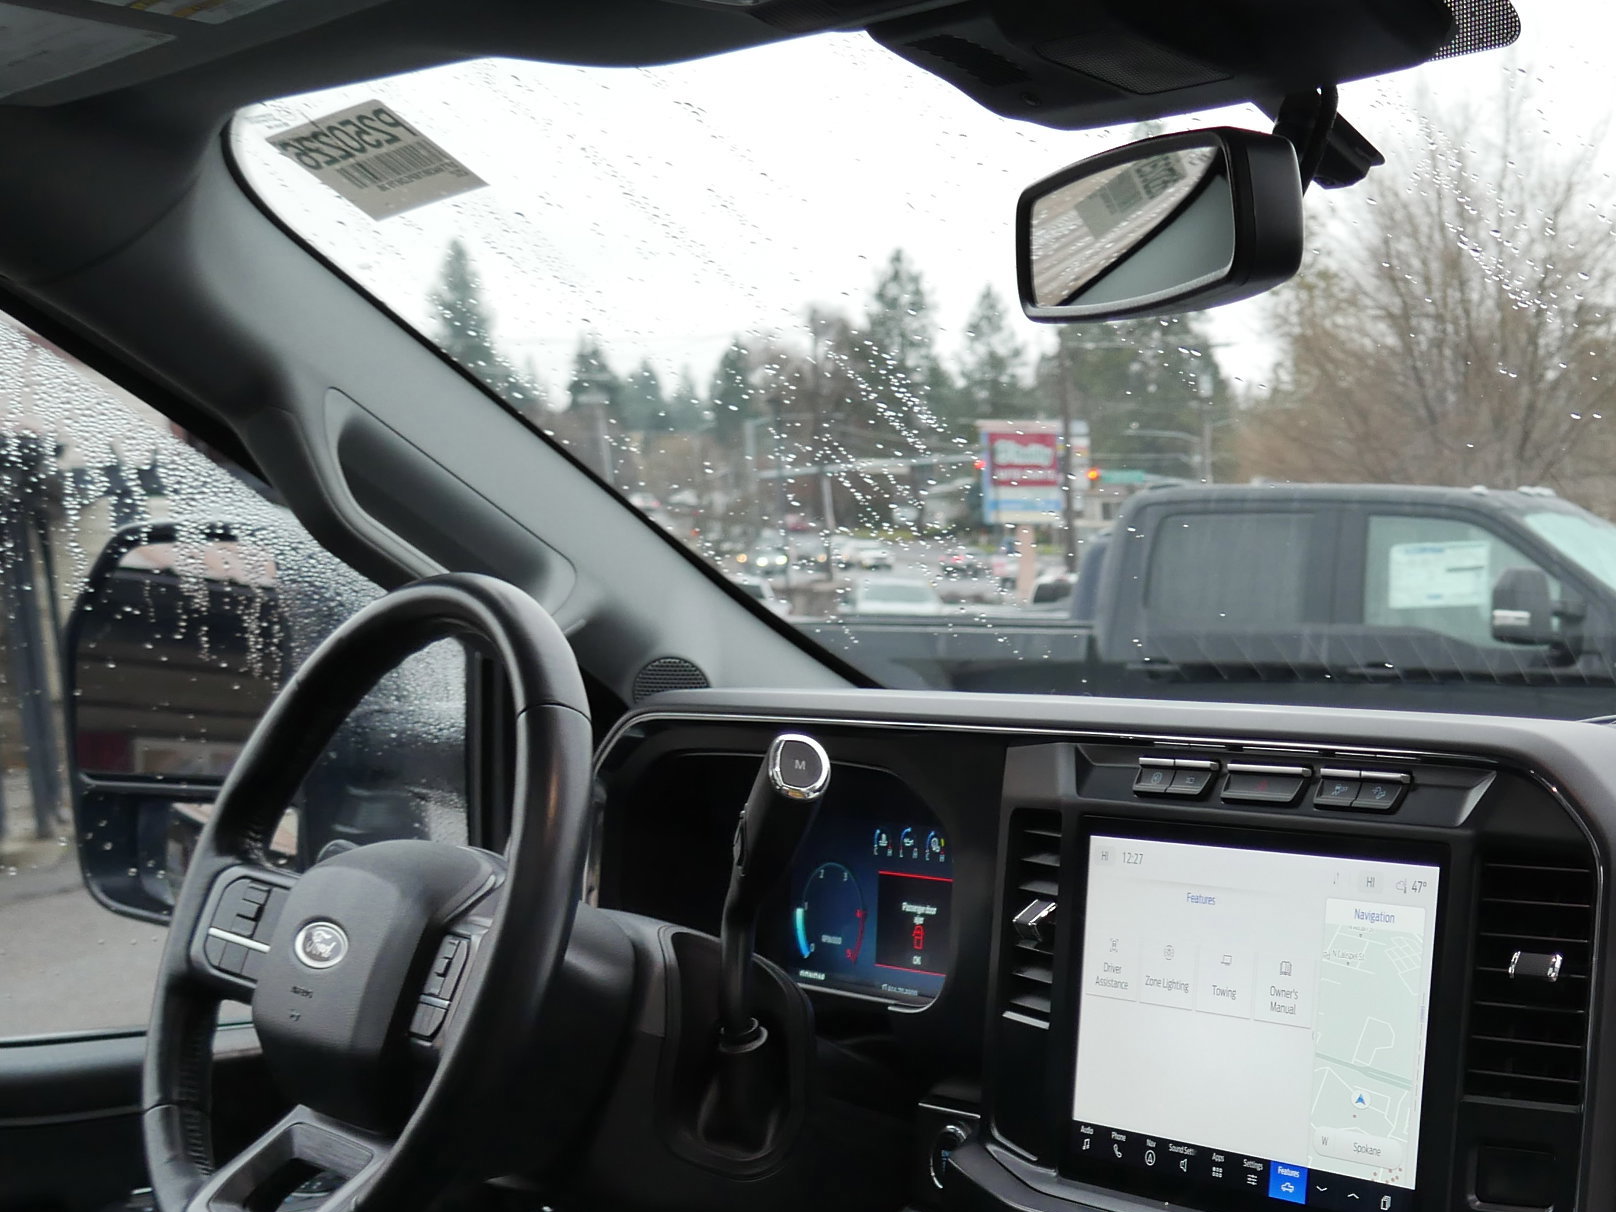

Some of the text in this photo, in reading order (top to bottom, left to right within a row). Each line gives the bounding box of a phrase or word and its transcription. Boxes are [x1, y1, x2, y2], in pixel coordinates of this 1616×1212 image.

[794, 759, 806, 770] M
[1101, 851, 1144, 864] HI 12:27
[1366, 877, 1427, 893] HI 47°
[1186, 892, 1216, 905] Features
[1354, 908, 1396, 924] Navigation
[1103, 961, 1122, 974] Driver
[1095, 976, 1128, 990] Assistance
[1145, 975, 1189, 993] Zone Lighting
[1212, 984, 1237, 1000] Towing
[1269, 985, 1299, 1000] Owner's
[1270, 1001, 1297, 1015] Manual
[1080, 1125, 1094, 1135] Audio
[1111, 1131, 1127, 1142] Phone
[1146, 1139, 1157, 1148] Nav
[1321, 1136, 1329, 1146] W
[1168, 1143, 1184, 1154] Sound
[1353, 1142, 1382, 1157] Spokane
[1212, 1152, 1225, 1163] Apps
[1242, 1158, 1264, 1171] Settings
[1277, 1165, 1300, 1178] Features
